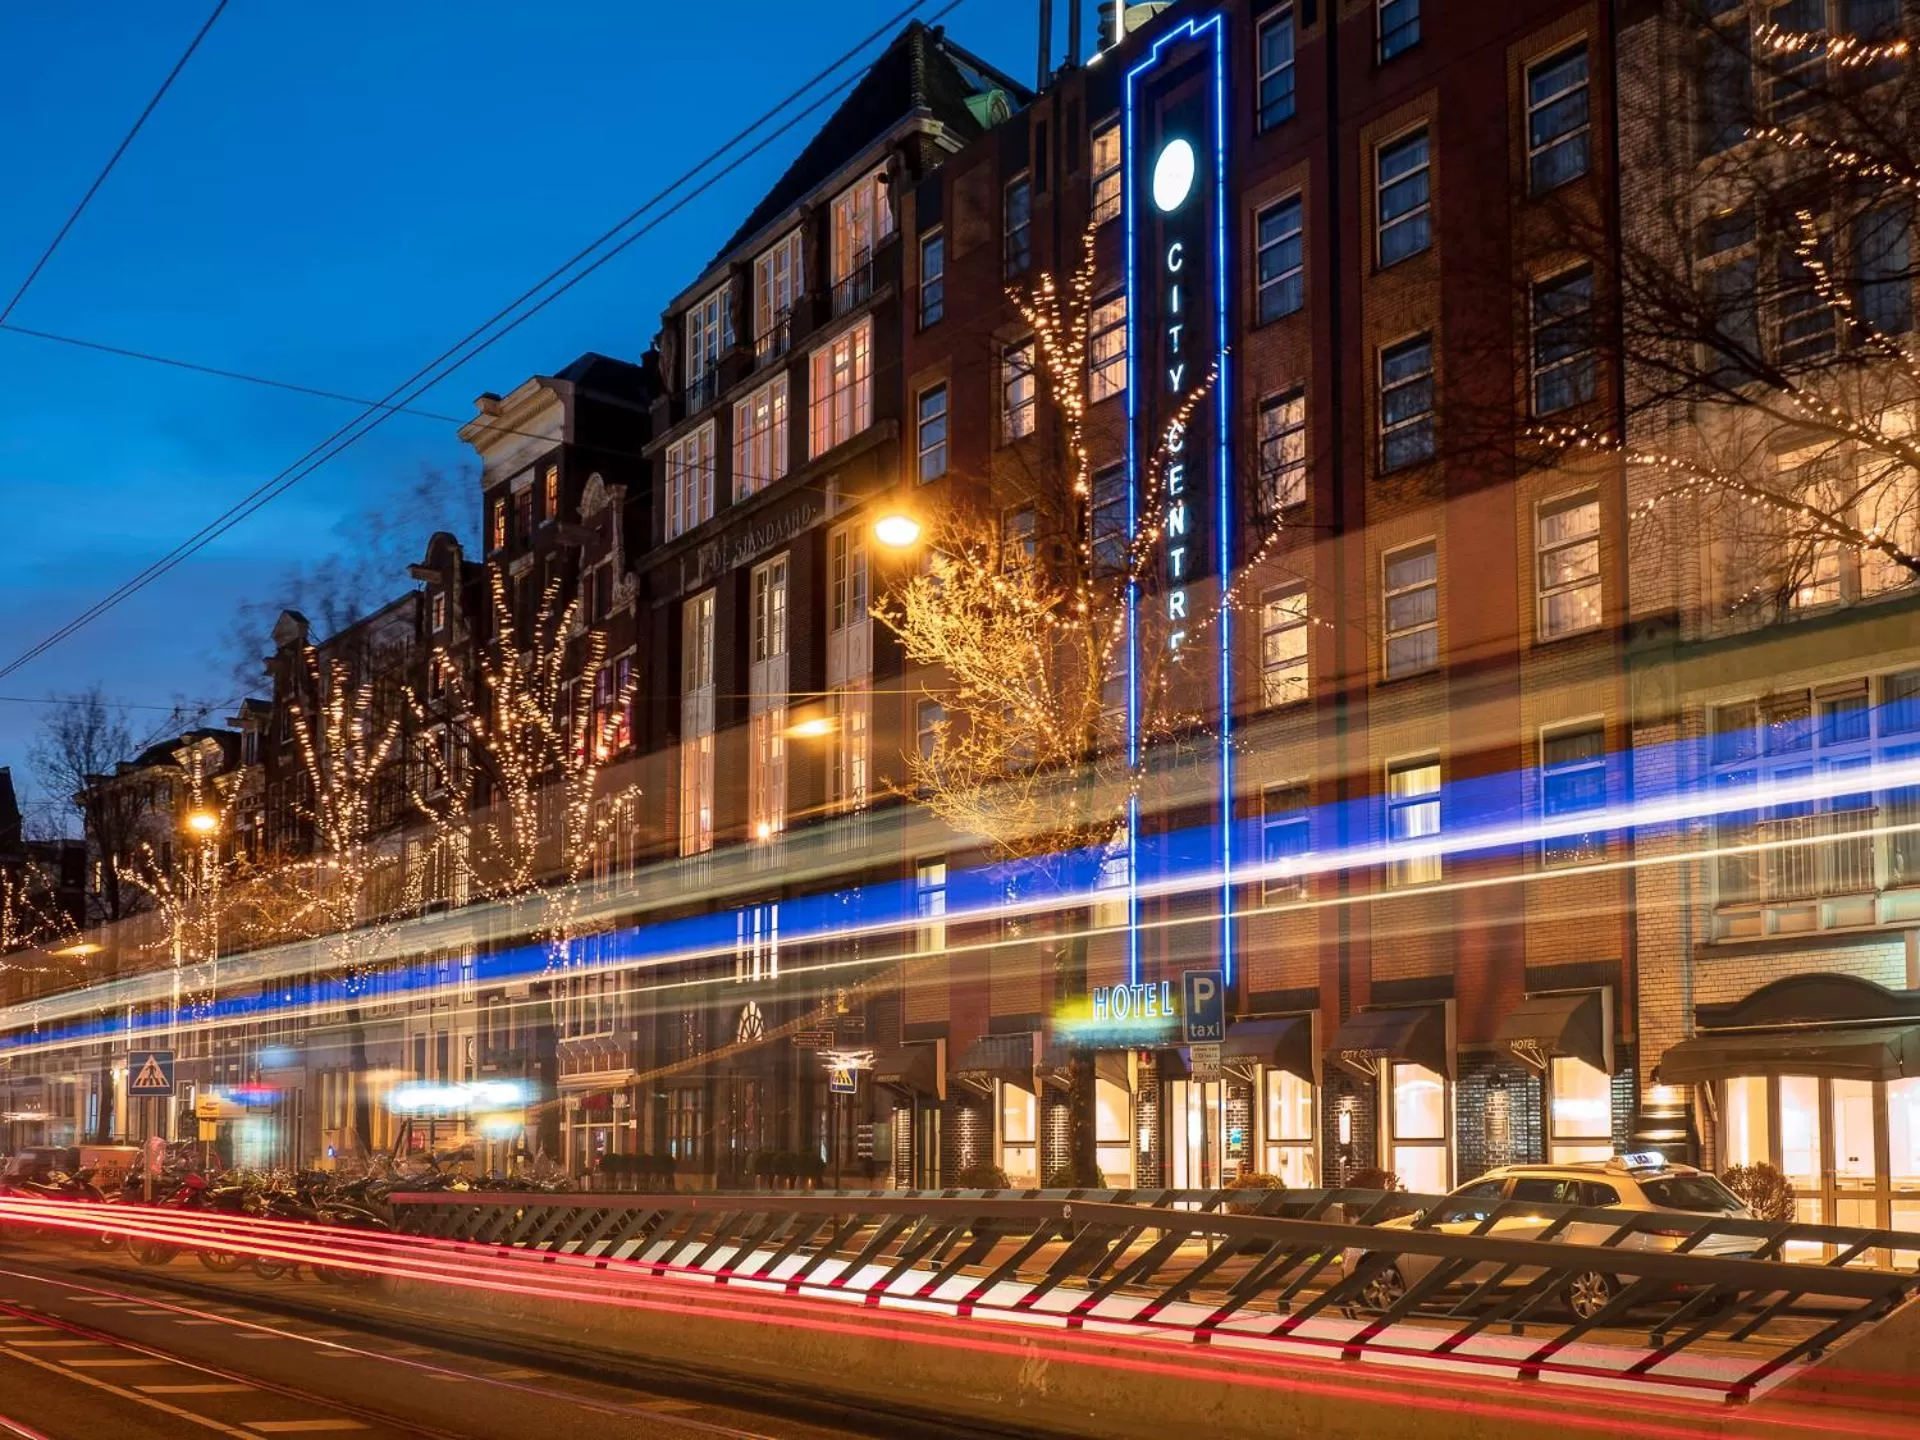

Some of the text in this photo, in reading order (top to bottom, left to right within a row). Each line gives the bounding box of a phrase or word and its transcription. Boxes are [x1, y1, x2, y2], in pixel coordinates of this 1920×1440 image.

[1167, 242, 1185, 392] CITY
[1092, 981, 1174, 1021] HOTEL
[1192, 977, 1216, 1014] P
[1190, 1021, 1220, 1038] taxi
[1510, 1039, 1539, 1050] HOTEL
